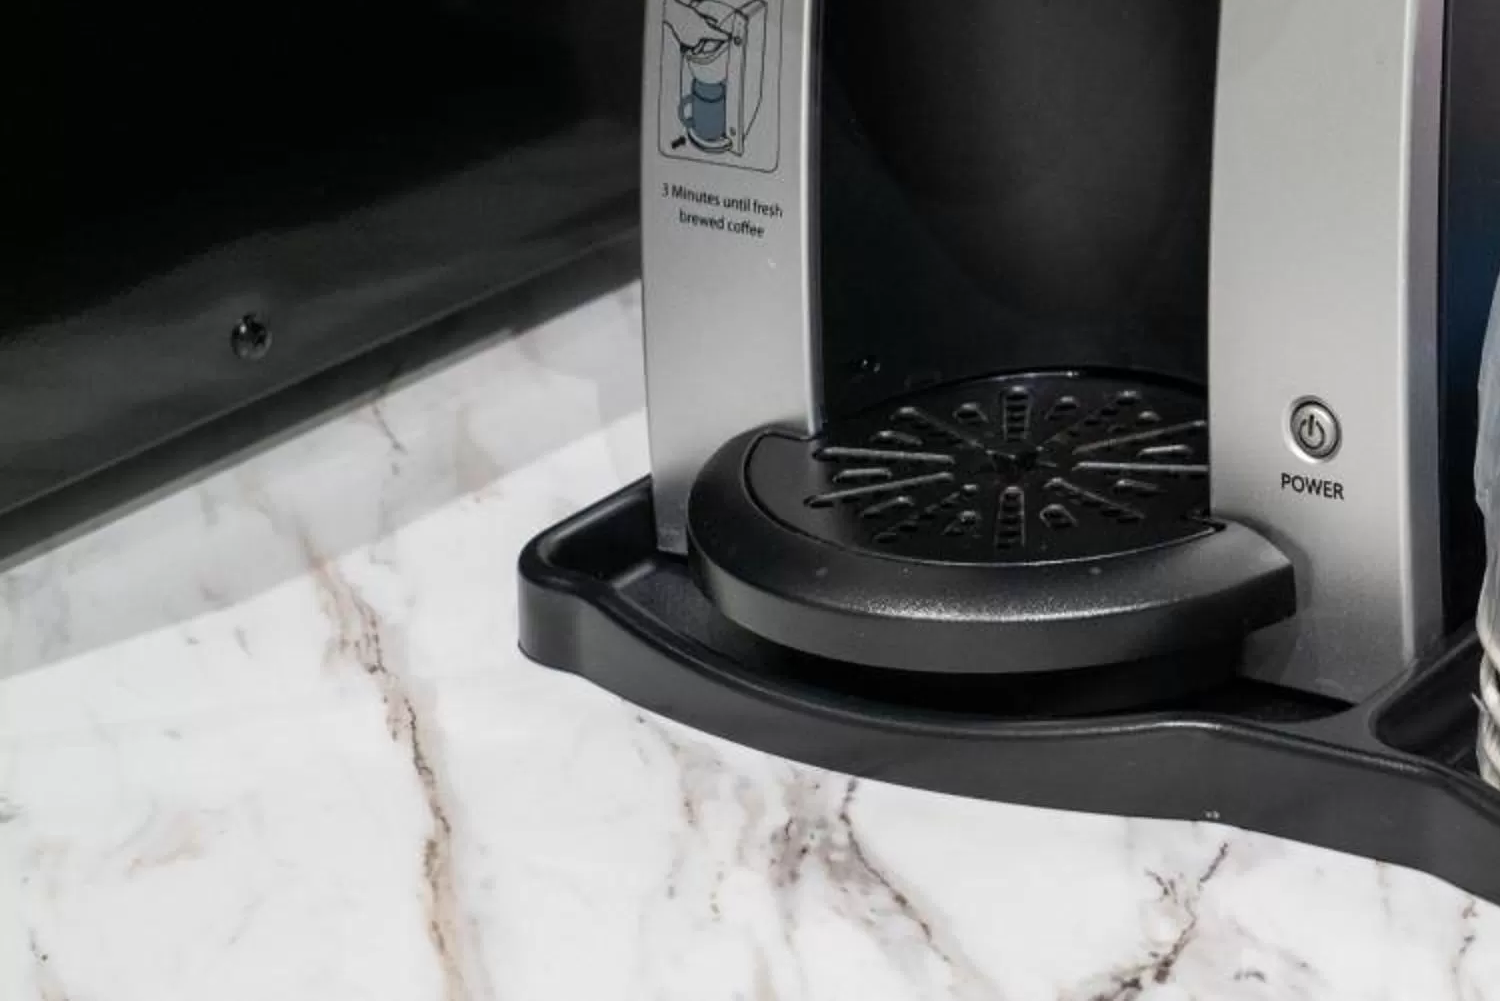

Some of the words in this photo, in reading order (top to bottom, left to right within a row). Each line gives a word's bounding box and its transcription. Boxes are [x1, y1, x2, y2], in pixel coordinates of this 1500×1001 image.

[661, 182, 669, 198] 3
[671, 184, 721, 206] Minutes
[723, 196, 750, 212] until
[752, 199, 783, 218] fresh
[679, 207, 724, 230] brewed
[727, 219, 765, 237] coffee
[1280, 472, 1344, 500] POWER
